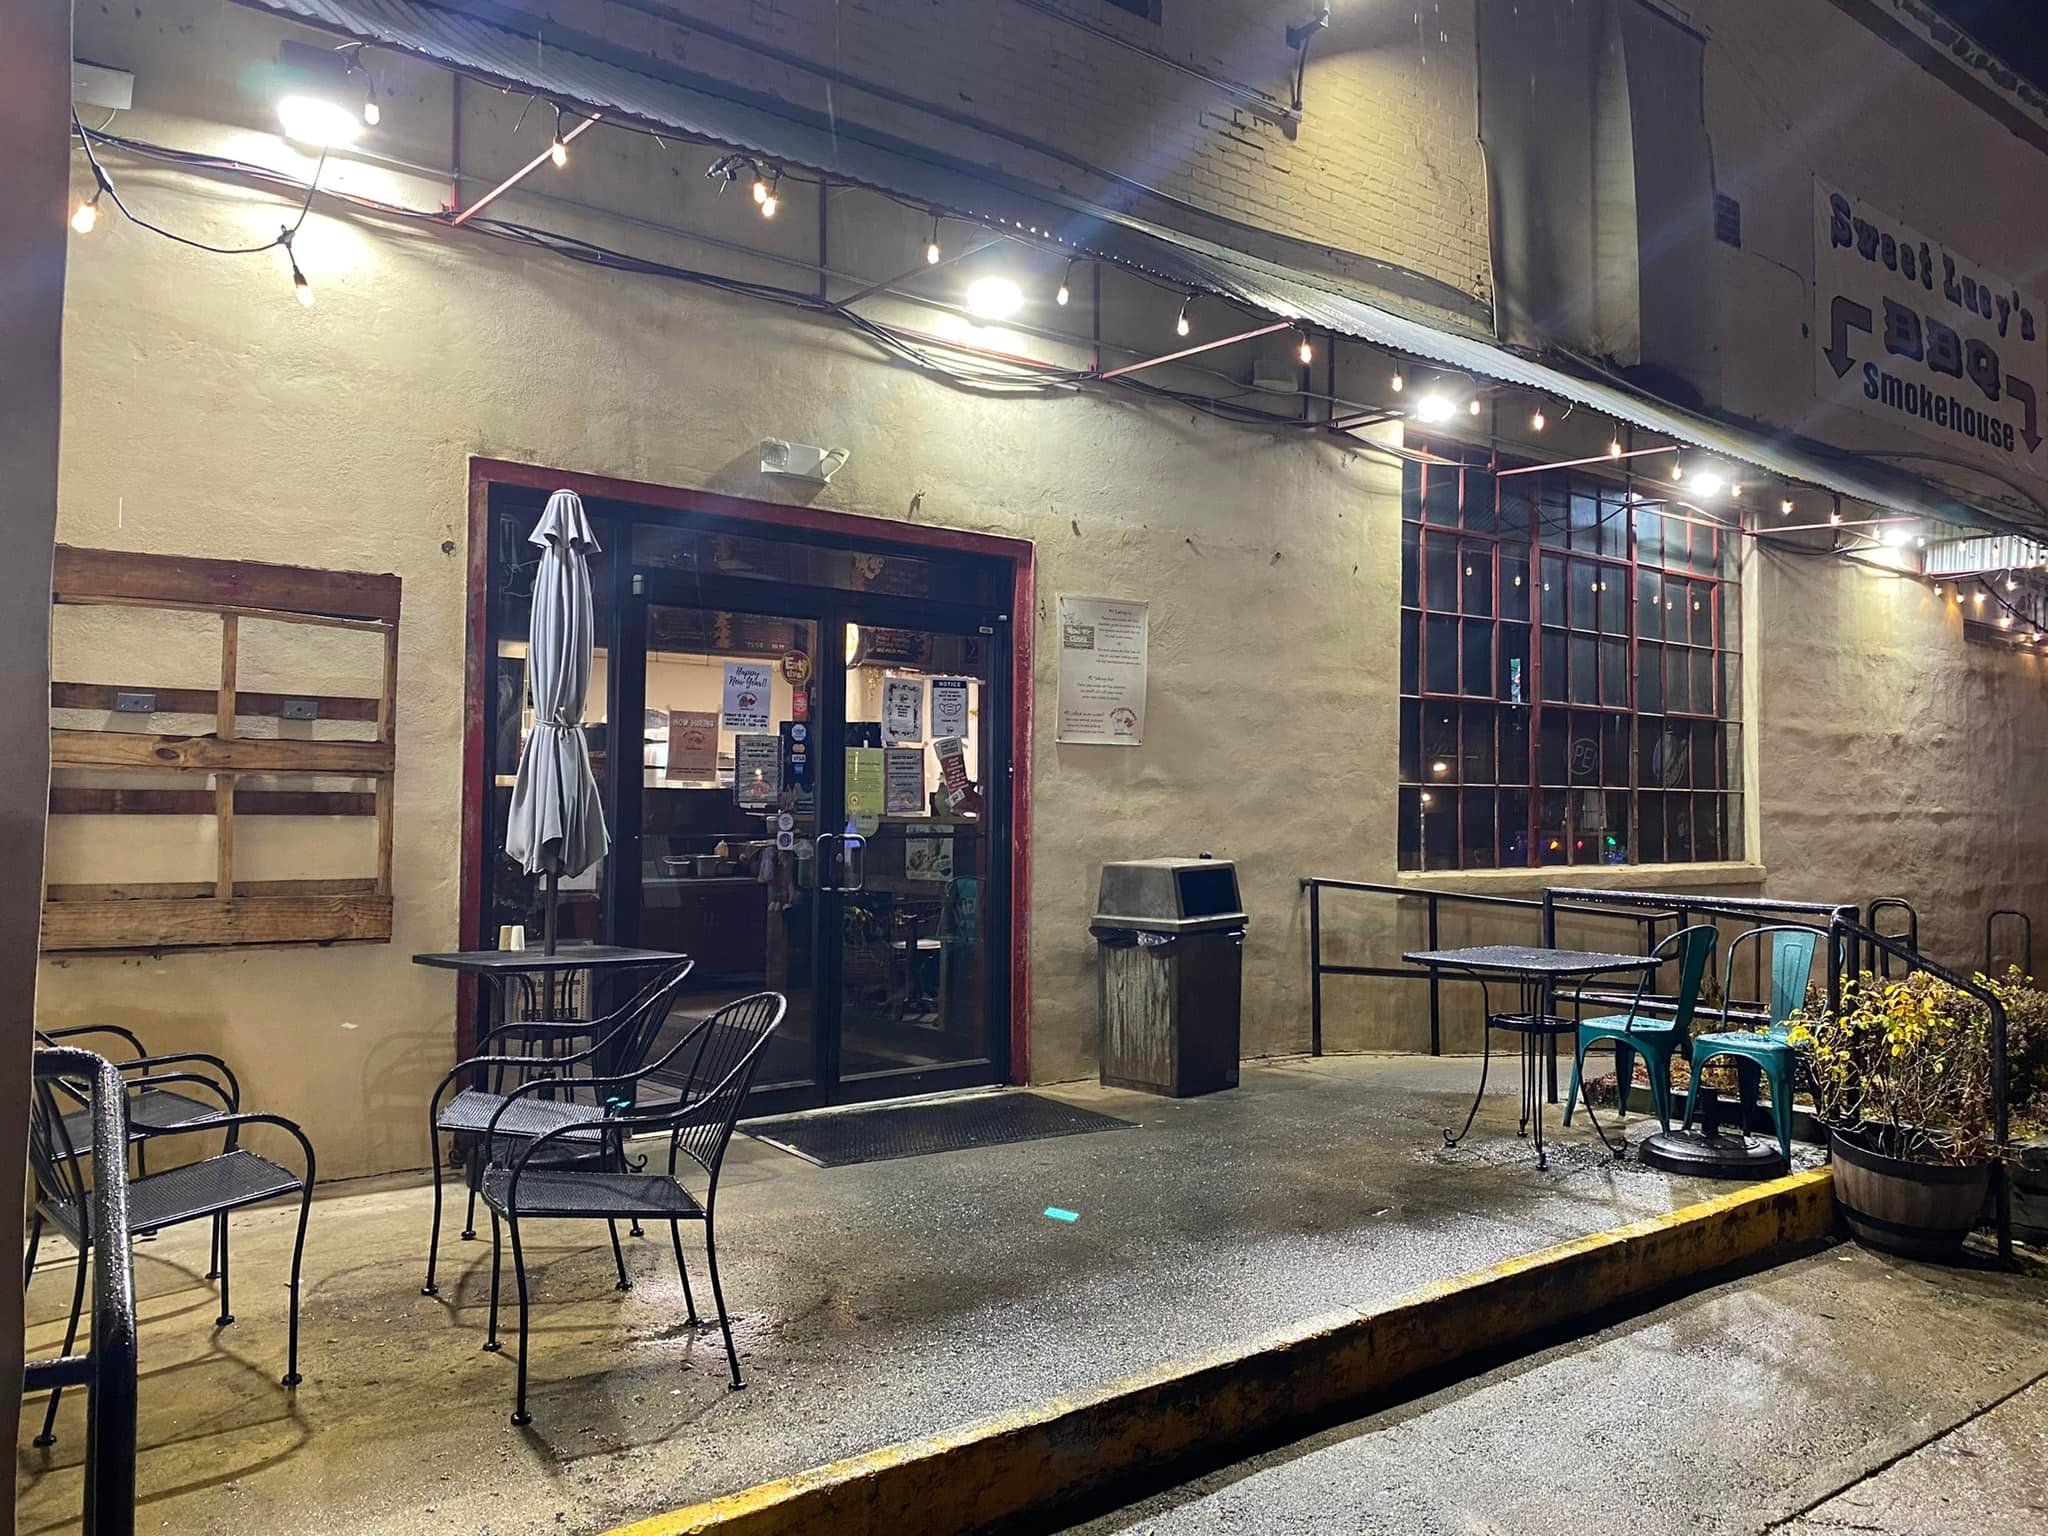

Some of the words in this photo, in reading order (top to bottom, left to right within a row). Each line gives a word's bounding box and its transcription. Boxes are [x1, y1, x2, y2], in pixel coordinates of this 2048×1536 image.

[1830, 193, 1933, 290] Sweet
[1942, 253, 2035, 341] Lucy's
[1882, 296, 2001, 401] BBQ
[1863, 361, 2015, 452] Smokehouse
[728, 675, 745, 687] New
[735, 666, 760, 680] Happy
